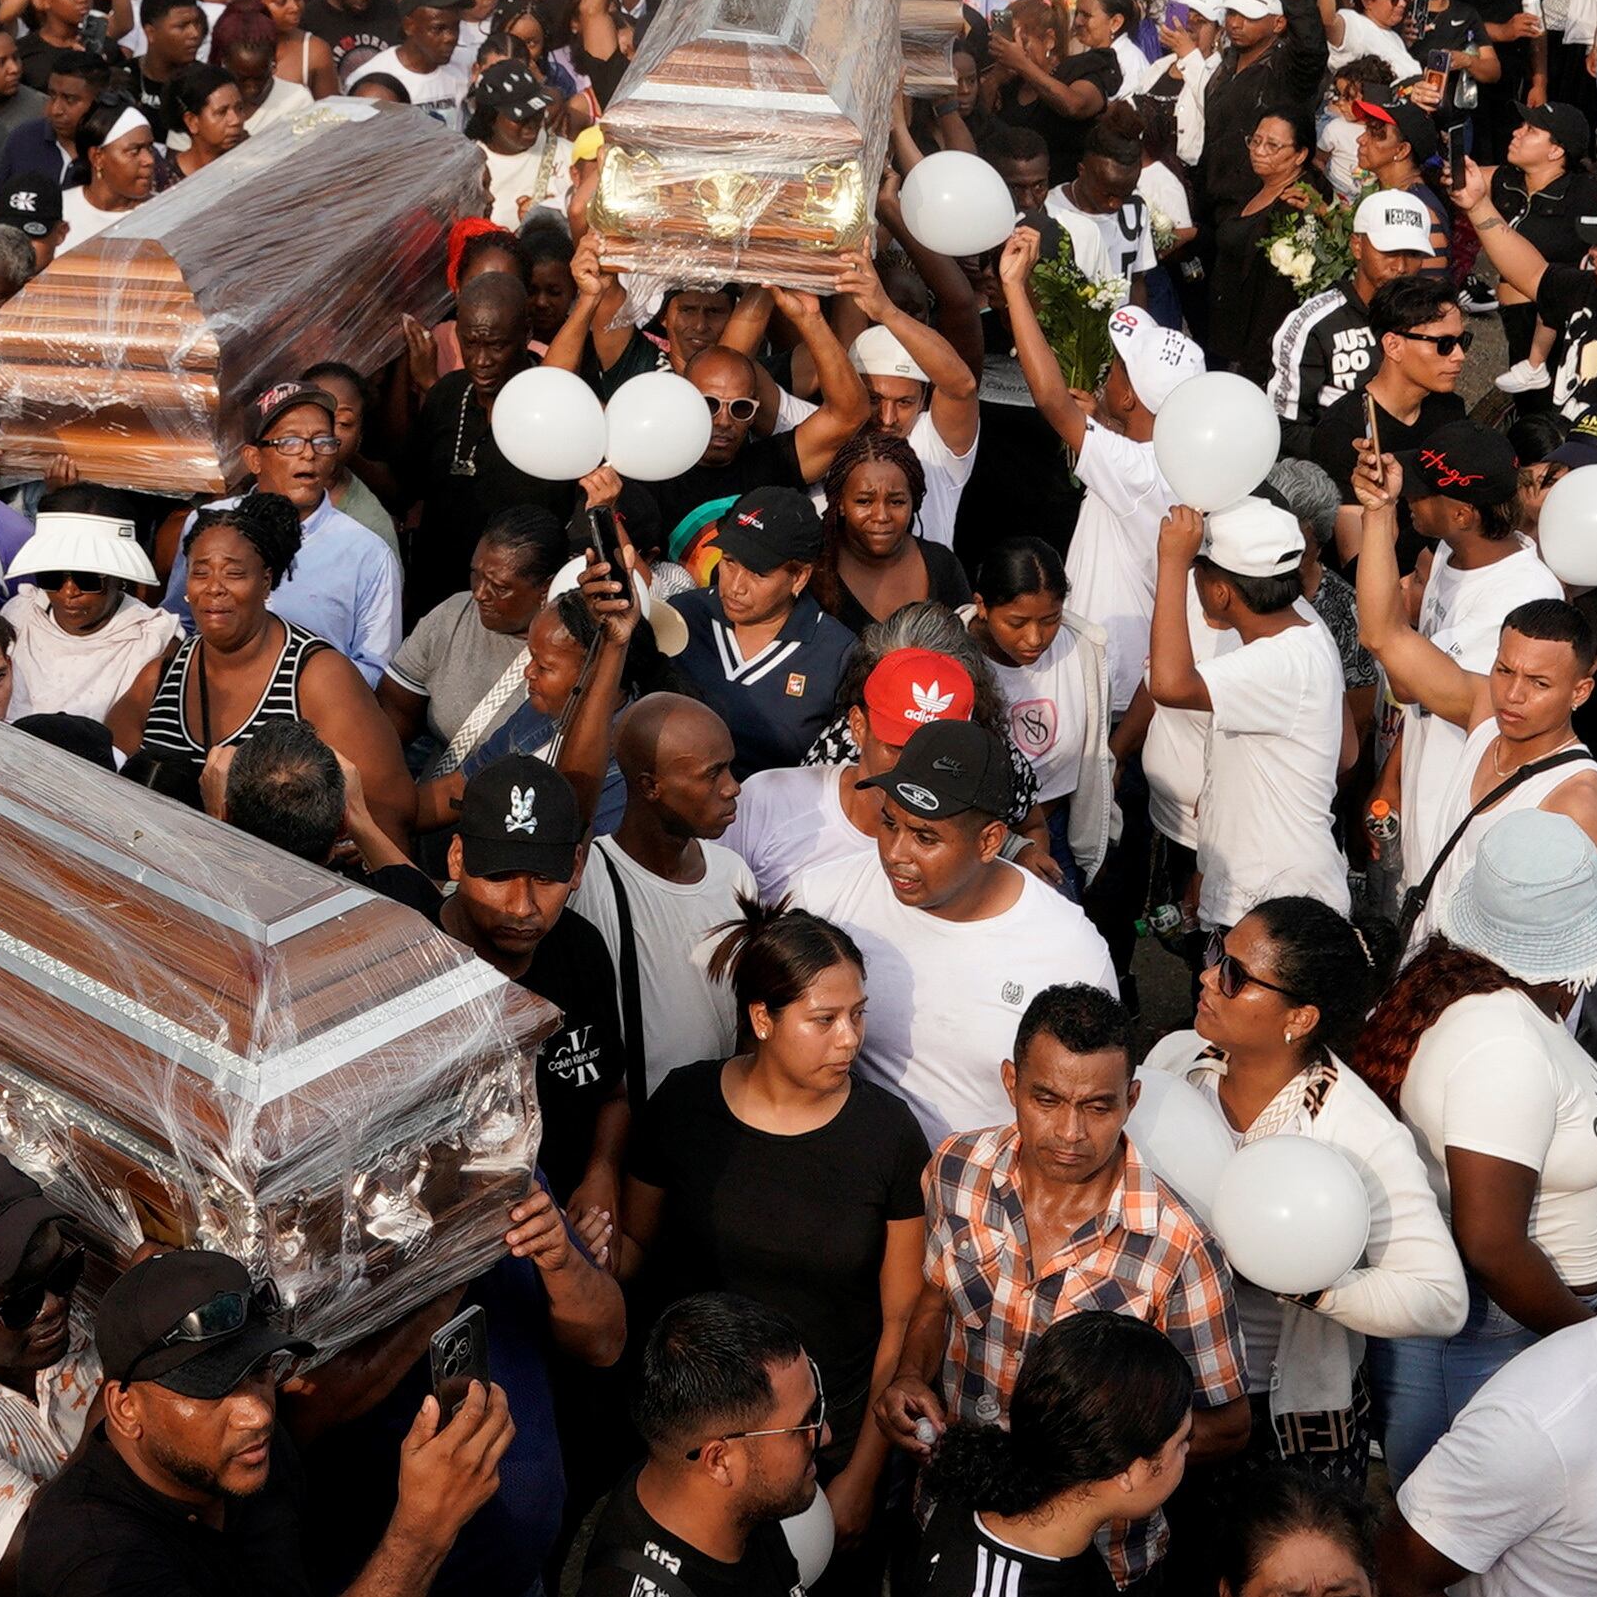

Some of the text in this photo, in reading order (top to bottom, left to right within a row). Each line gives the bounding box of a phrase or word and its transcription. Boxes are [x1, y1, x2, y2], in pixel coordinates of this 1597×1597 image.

[1332, 327, 1377, 353] JUST
[1332, 349, 1370, 376] DO
[905, 708, 941, 723] adid
[547, 1057, 573, 1072] Calvin
